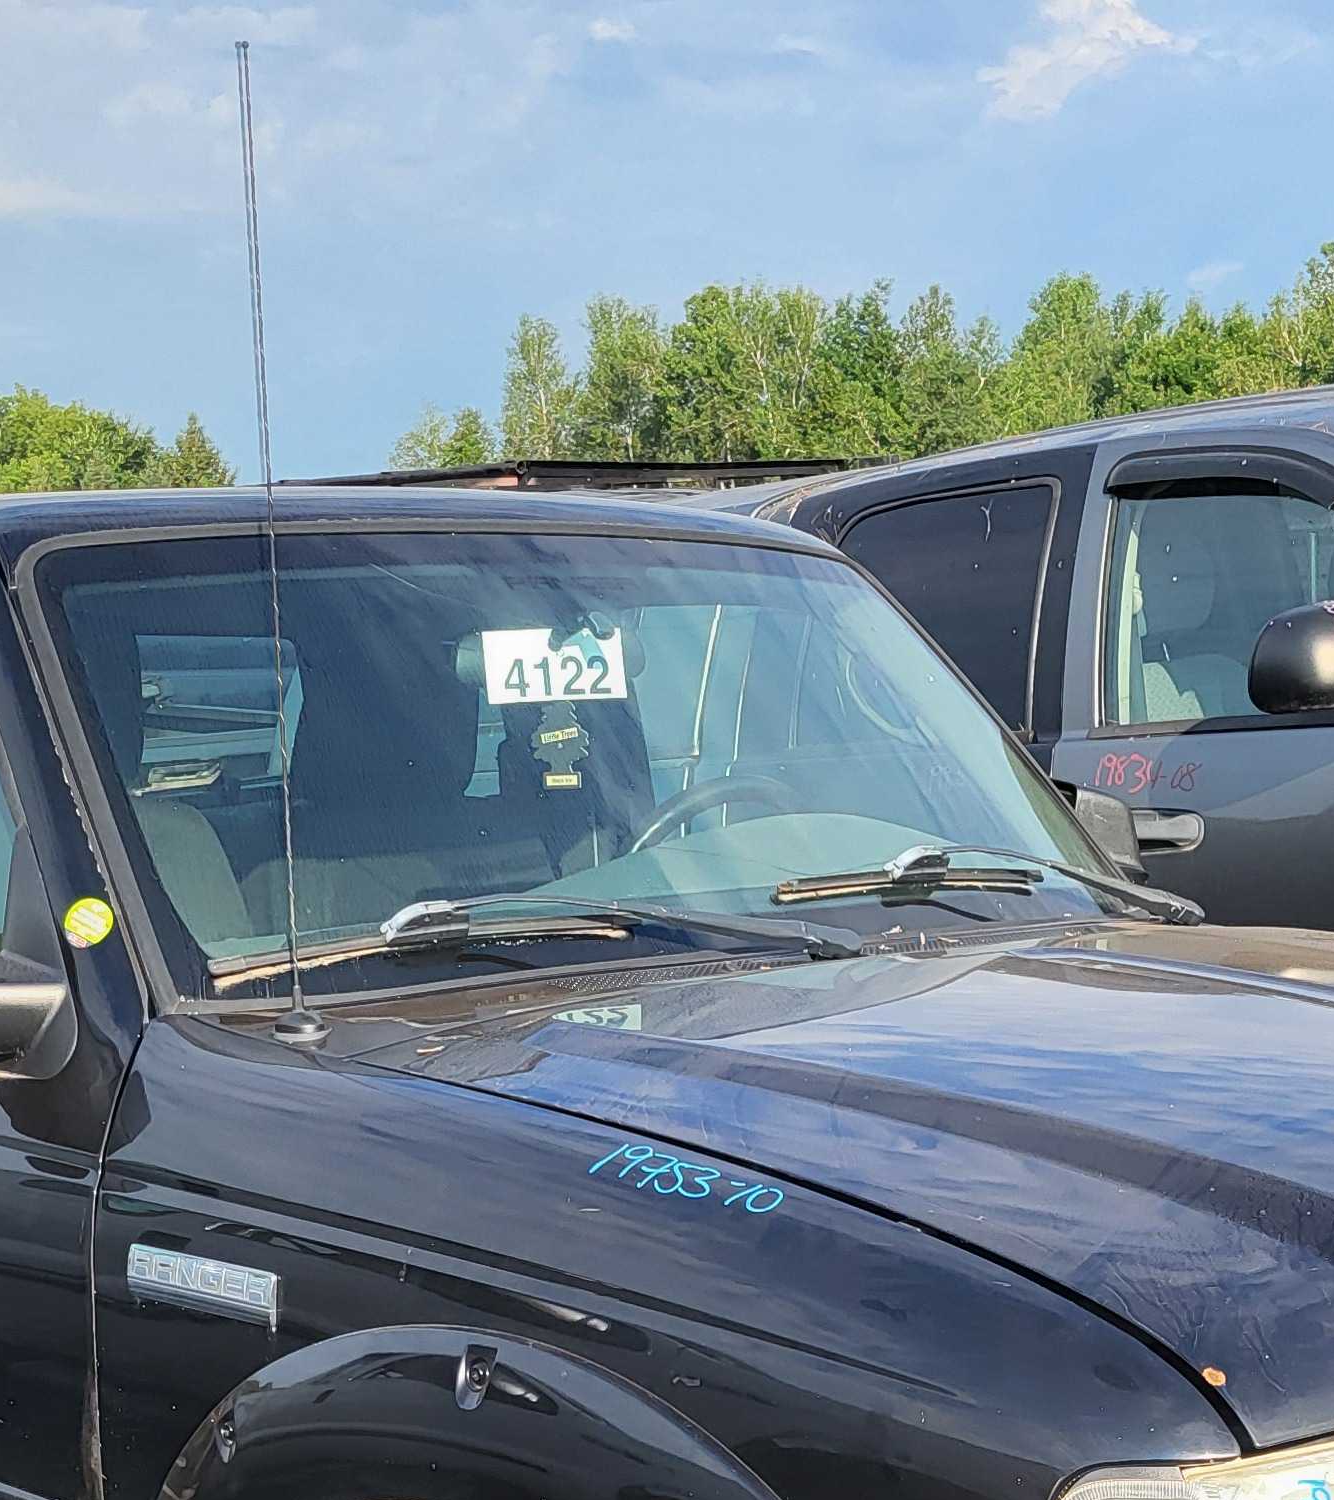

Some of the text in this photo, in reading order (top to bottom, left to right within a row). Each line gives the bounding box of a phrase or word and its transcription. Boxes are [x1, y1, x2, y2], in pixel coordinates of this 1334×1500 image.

[504, 655, 612, 698] 4122
[588, 1143, 784, 1213] 19753-10
[130, 1248, 273, 1307] RANGER
